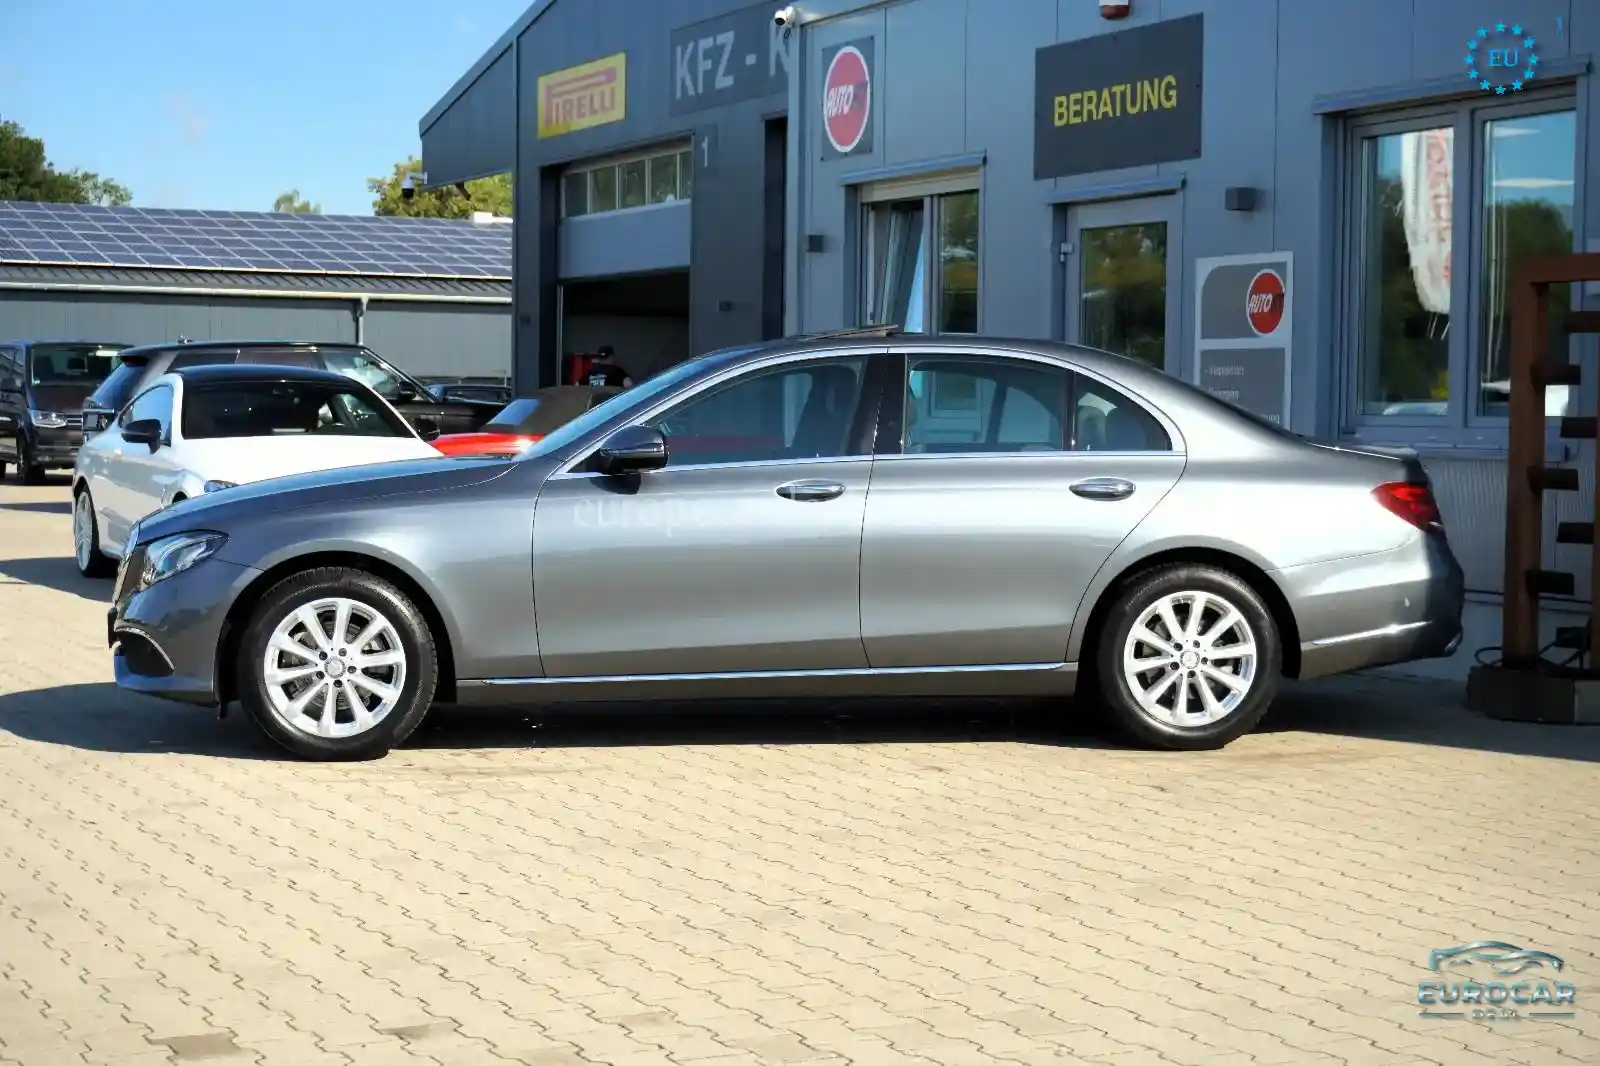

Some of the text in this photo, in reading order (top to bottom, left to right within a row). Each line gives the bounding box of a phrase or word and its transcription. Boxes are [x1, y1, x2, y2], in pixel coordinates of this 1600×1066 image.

[675, 30, 735, 100] KFZ
[543, 66, 617, 130] PIRELLI
[826, 84, 854, 118] AUTO
[1053, 74, 1178, 128] BERATUNG
[701, 135, 709, 168] 1
[1248, 292, 1274, 316] AUTO
